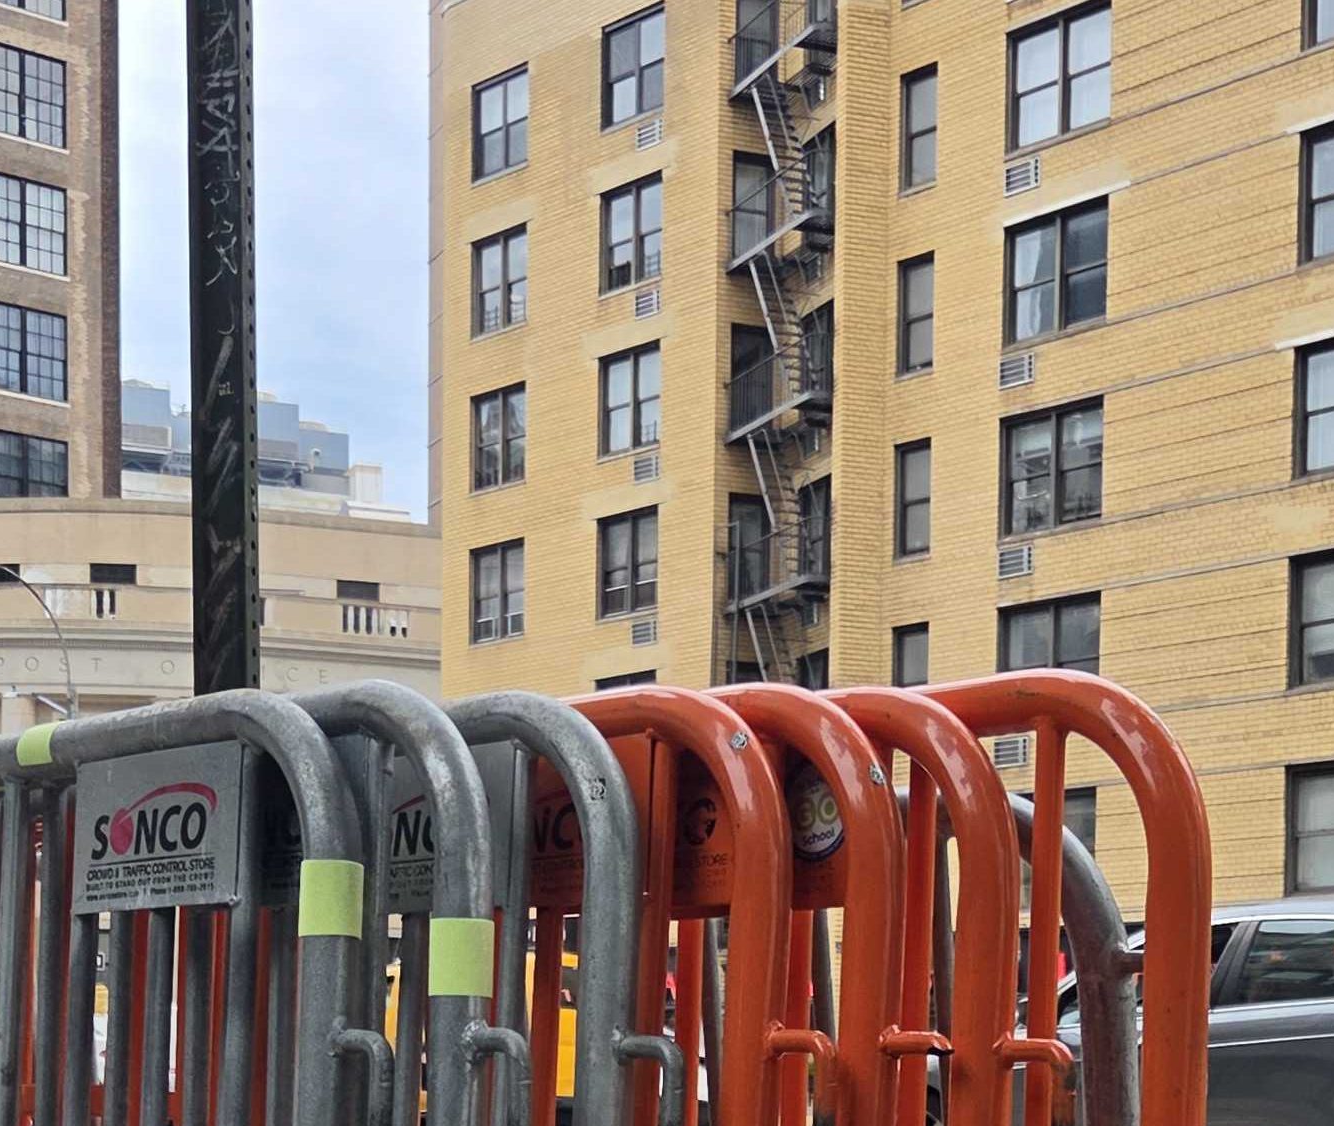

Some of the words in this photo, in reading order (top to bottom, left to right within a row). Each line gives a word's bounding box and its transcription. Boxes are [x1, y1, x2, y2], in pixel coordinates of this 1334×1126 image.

[161, 659, 330, 685] OICE
[91, 802, 208, 861] SONCO
[152, 860, 188, 875] CONTROL
[188, 856, 216, 870] STORE
